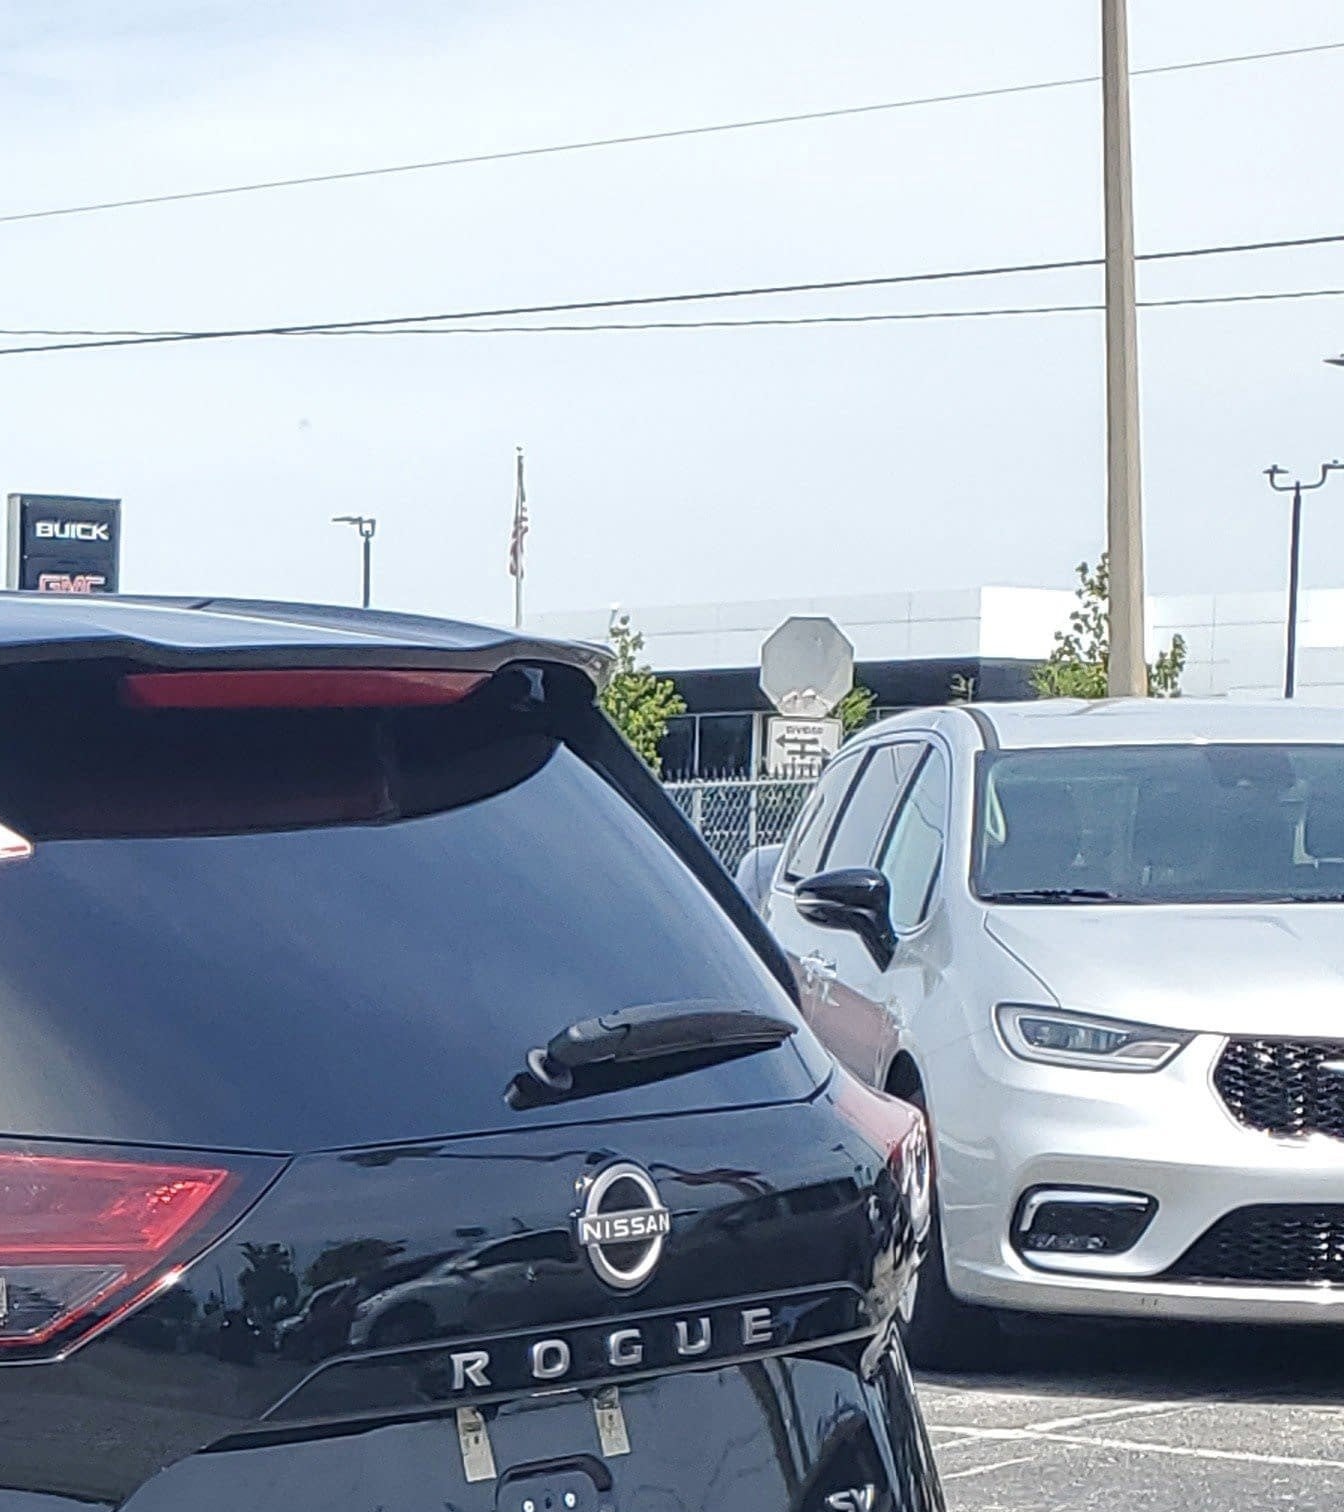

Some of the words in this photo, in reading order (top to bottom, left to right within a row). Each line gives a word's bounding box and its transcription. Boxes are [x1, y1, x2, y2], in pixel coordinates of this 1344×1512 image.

[36, 521, 110, 541] BUICK
[583, 1212, 670, 1242] NISSAN
[450, 1307, 774, 1390] ROGUE
